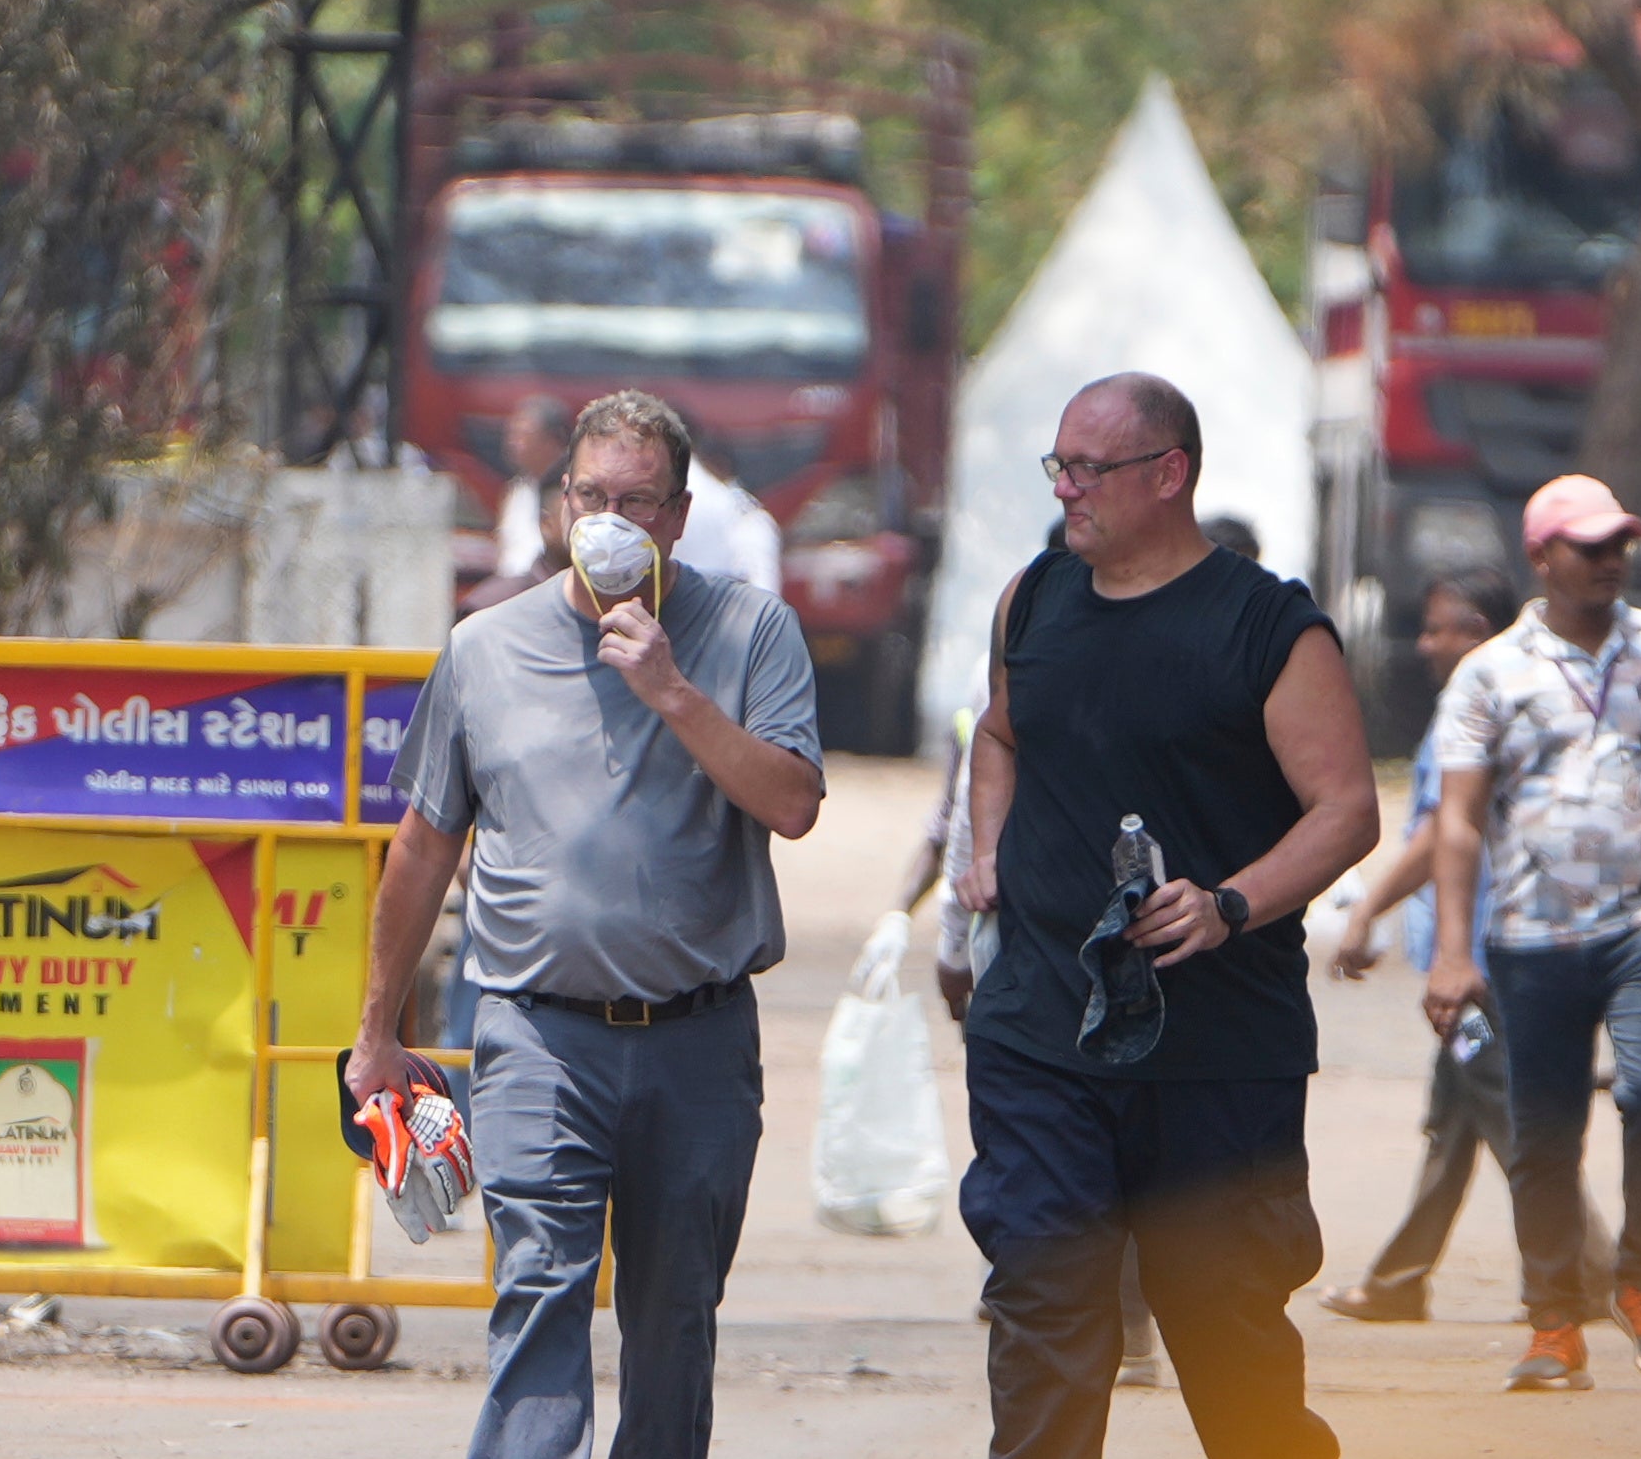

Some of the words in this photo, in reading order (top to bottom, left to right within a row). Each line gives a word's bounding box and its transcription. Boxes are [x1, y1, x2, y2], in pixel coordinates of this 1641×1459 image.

[52, 692, 190, 747] પોલીસ
[201, 697, 332, 751] સ્ટેશન
[40, 957, 137, 986] DUTY
